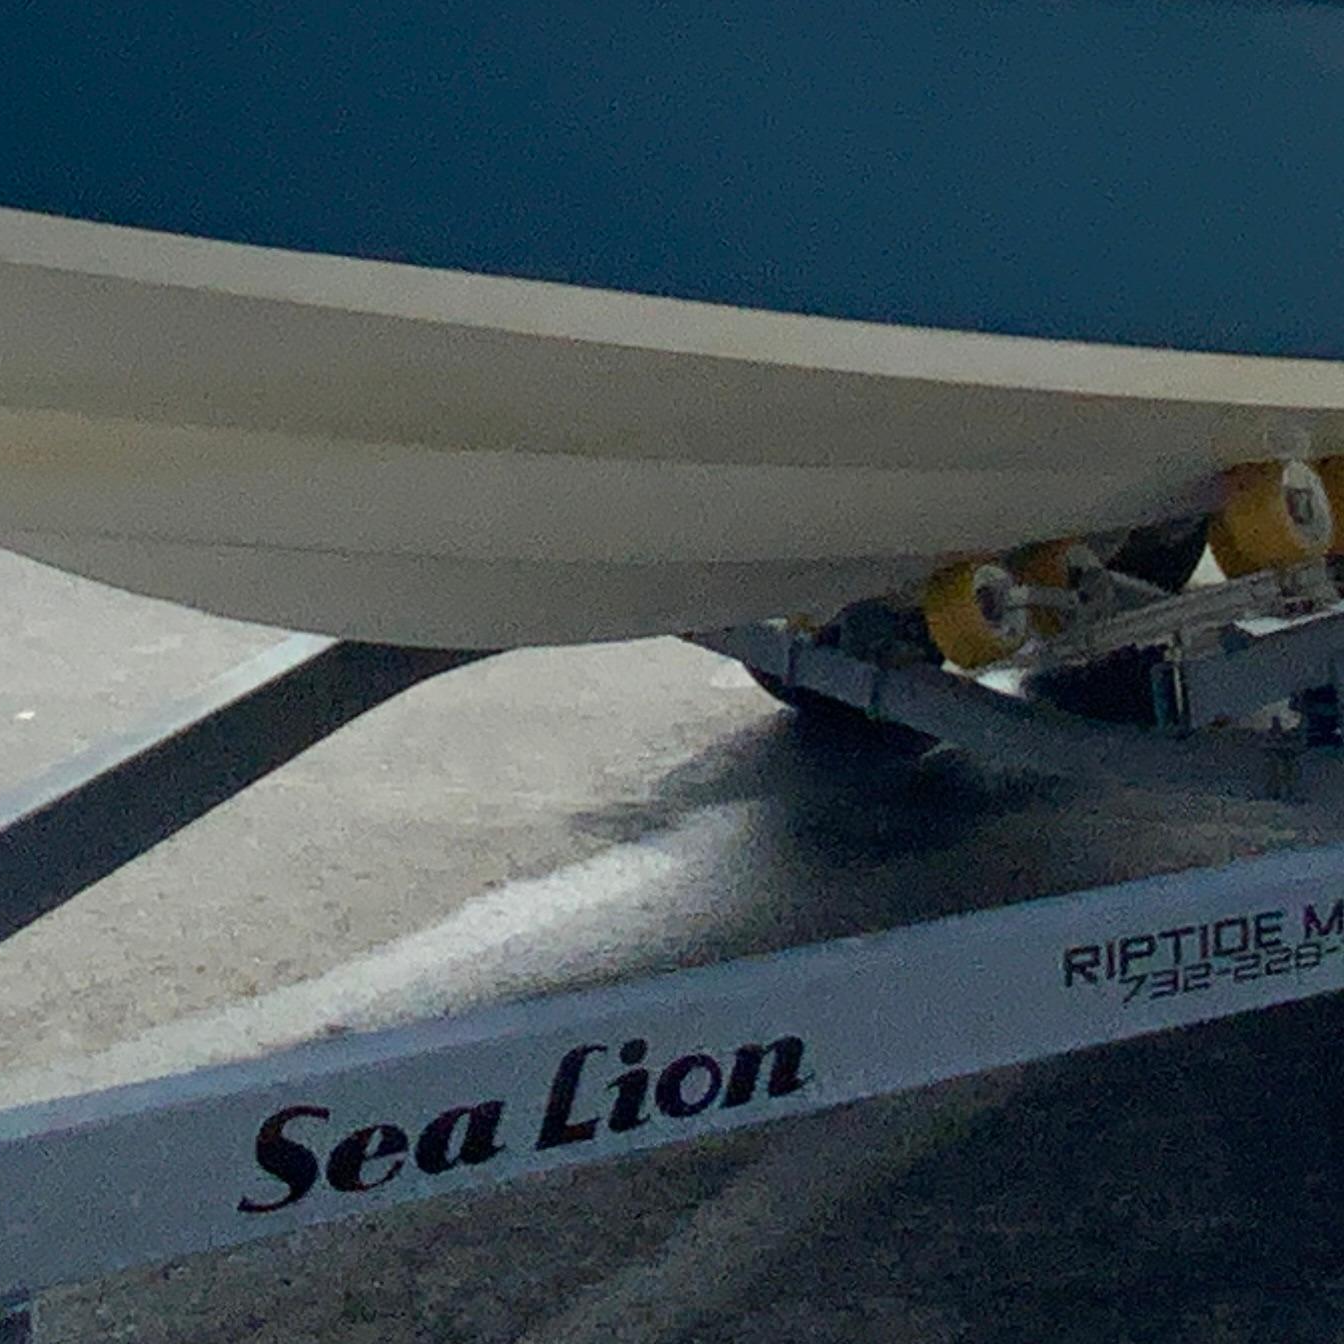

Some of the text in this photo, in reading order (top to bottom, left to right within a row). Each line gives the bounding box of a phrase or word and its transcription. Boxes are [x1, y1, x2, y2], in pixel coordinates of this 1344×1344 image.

[1063, 911, 1284, 987] RIPTIDE
[237, 1034, 813, 1214] Sea Lion
